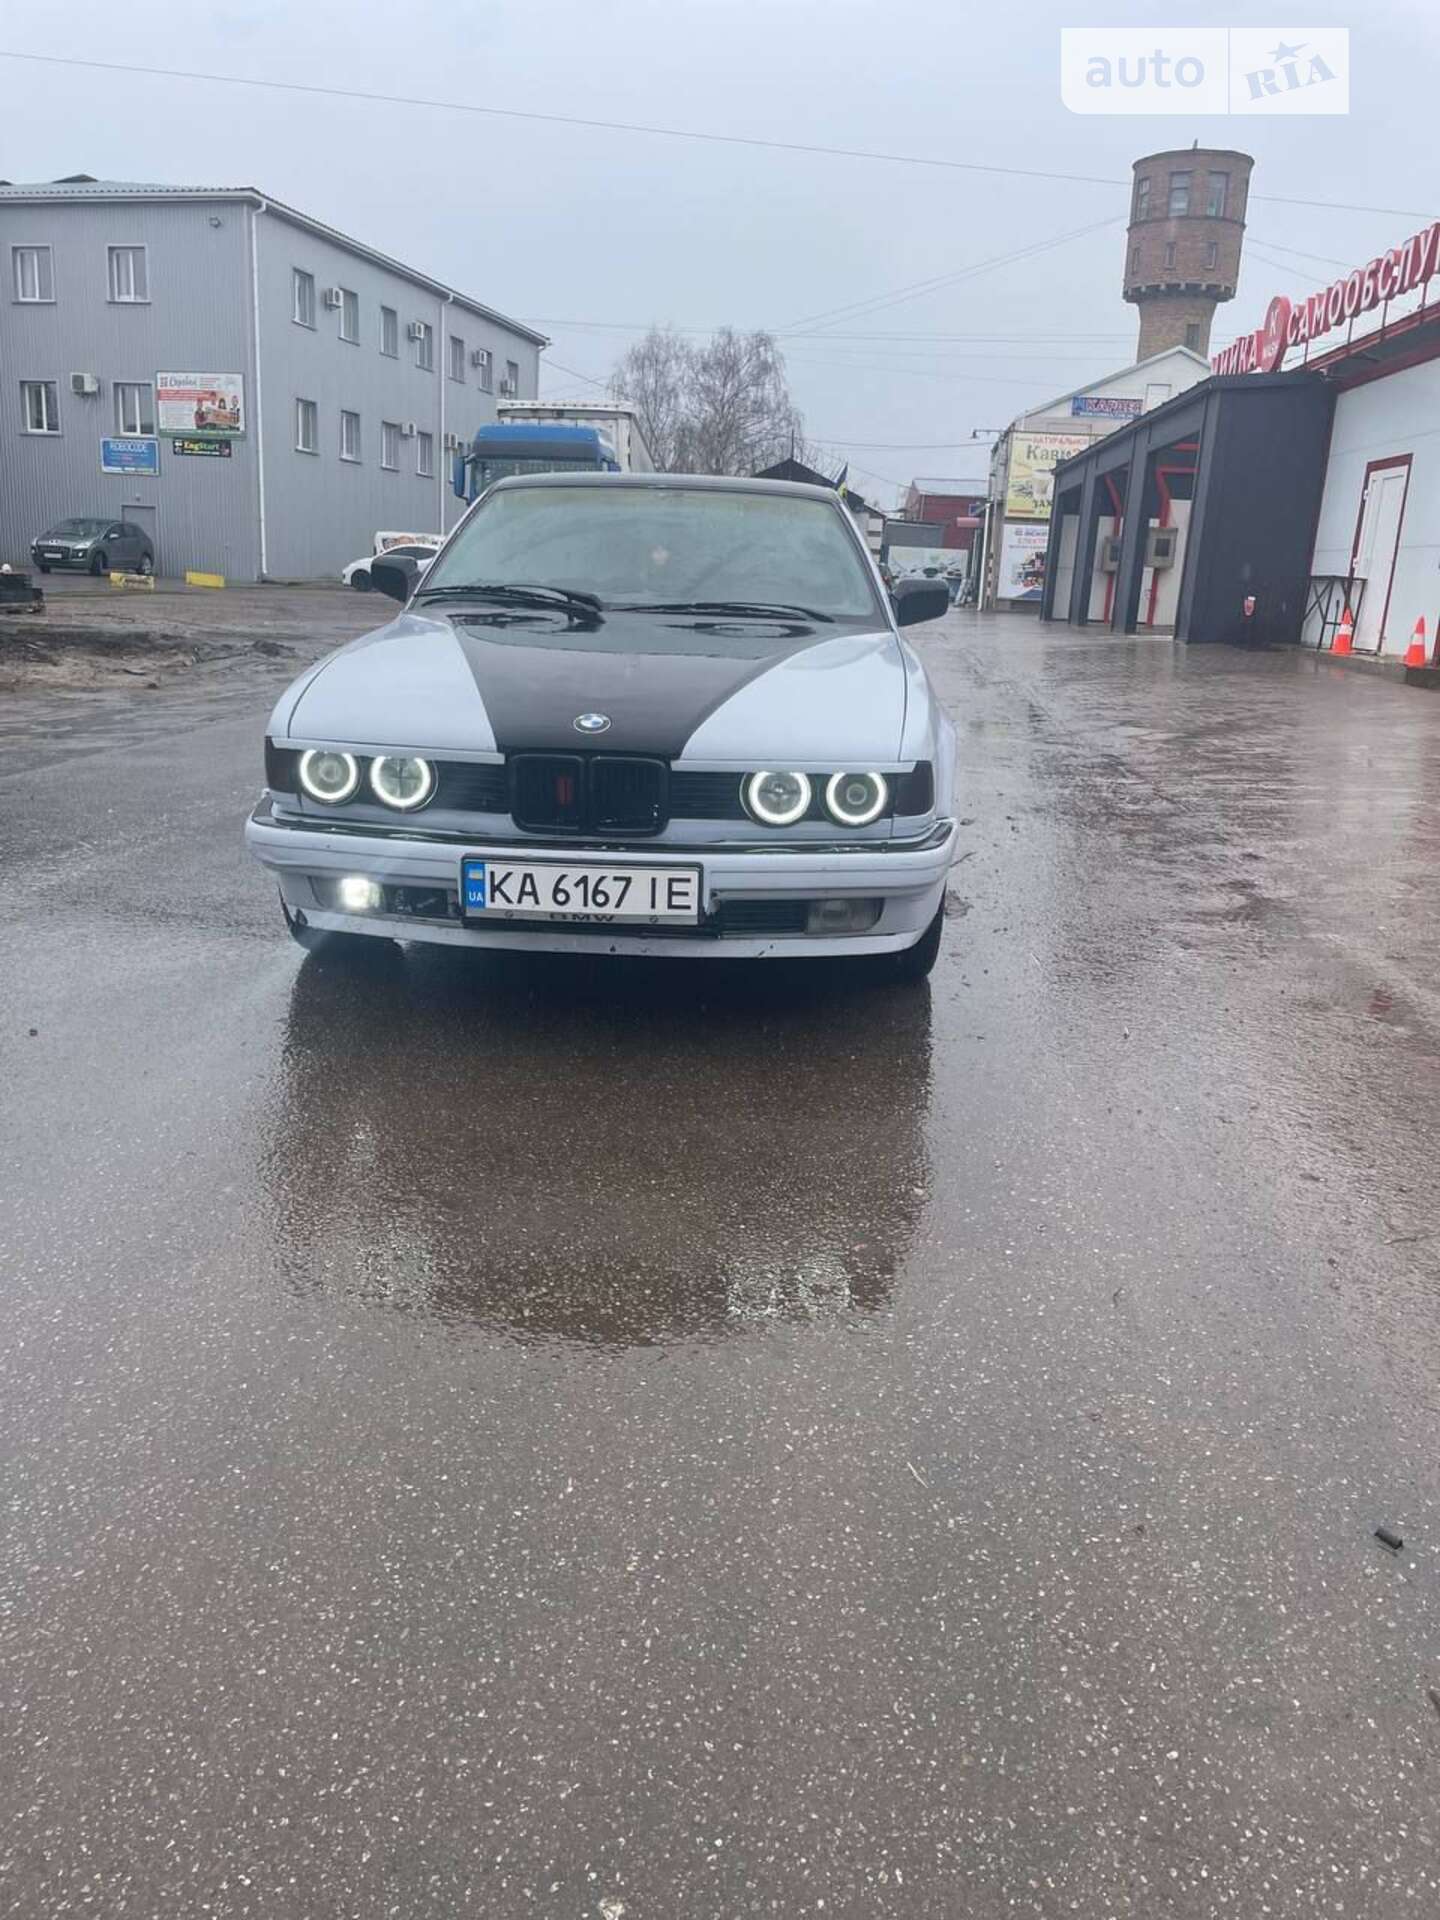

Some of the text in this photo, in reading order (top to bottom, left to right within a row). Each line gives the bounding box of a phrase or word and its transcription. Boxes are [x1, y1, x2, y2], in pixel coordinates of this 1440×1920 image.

[469, 892, 484, 902] UA
[490, 871, 691, 910] KA 6167 IE
